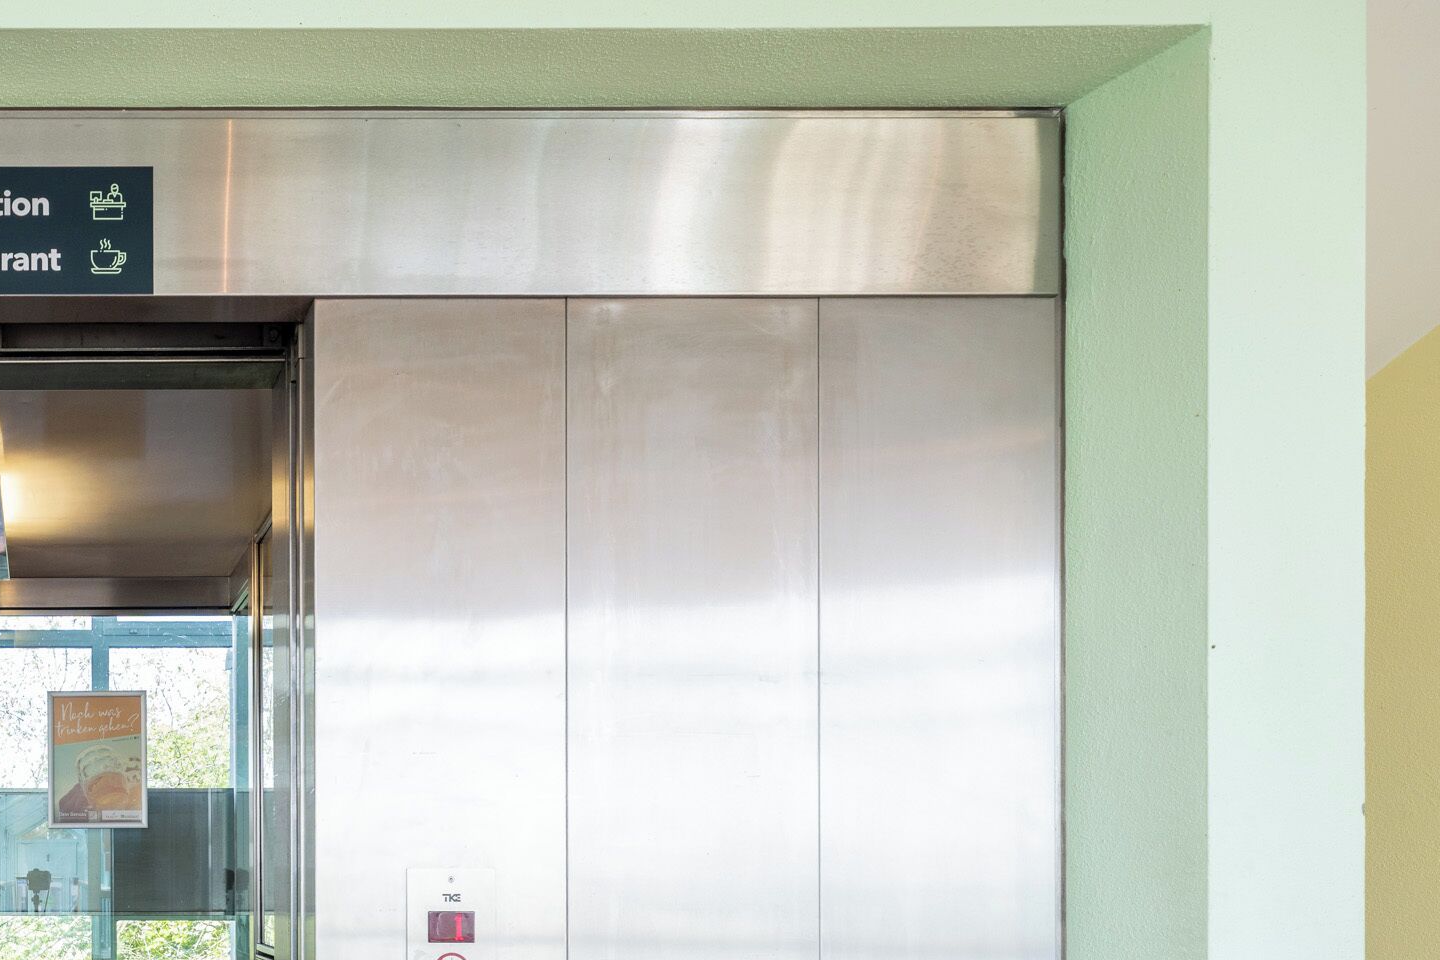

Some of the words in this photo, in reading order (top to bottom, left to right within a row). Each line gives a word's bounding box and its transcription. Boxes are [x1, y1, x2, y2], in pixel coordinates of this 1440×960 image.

[61, 701, 95, 722] Noch
[98, 707, 122, 719] was
[54, 718, 96, 737] trinken
[98, 712, 140, 741] gehen?
[442, 893, 461, 903] TKE
